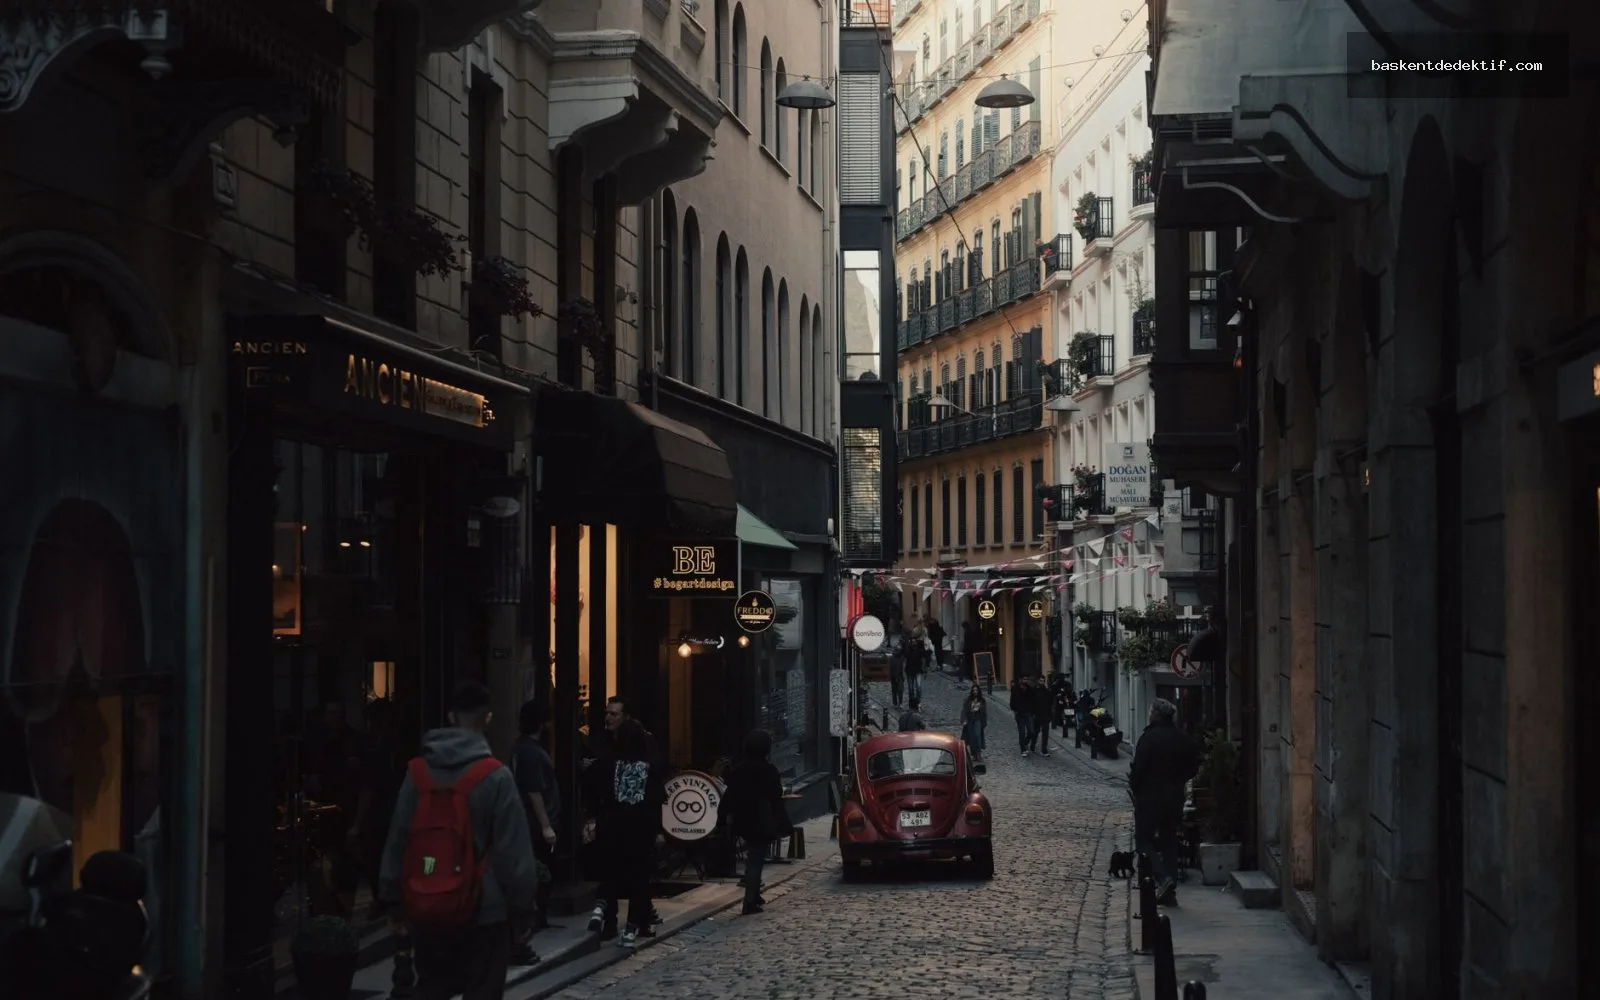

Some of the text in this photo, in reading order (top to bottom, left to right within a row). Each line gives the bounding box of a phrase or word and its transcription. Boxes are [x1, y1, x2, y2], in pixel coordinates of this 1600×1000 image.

[232, 341, 307, 355] ANCIEN
[343, 353, 425, 413] ANCIEN
[1109, 464, 1147, 475] DOĞAN
[672, 546, 715, 574] BE
[683, 778, 717, 808] VINTAGE
